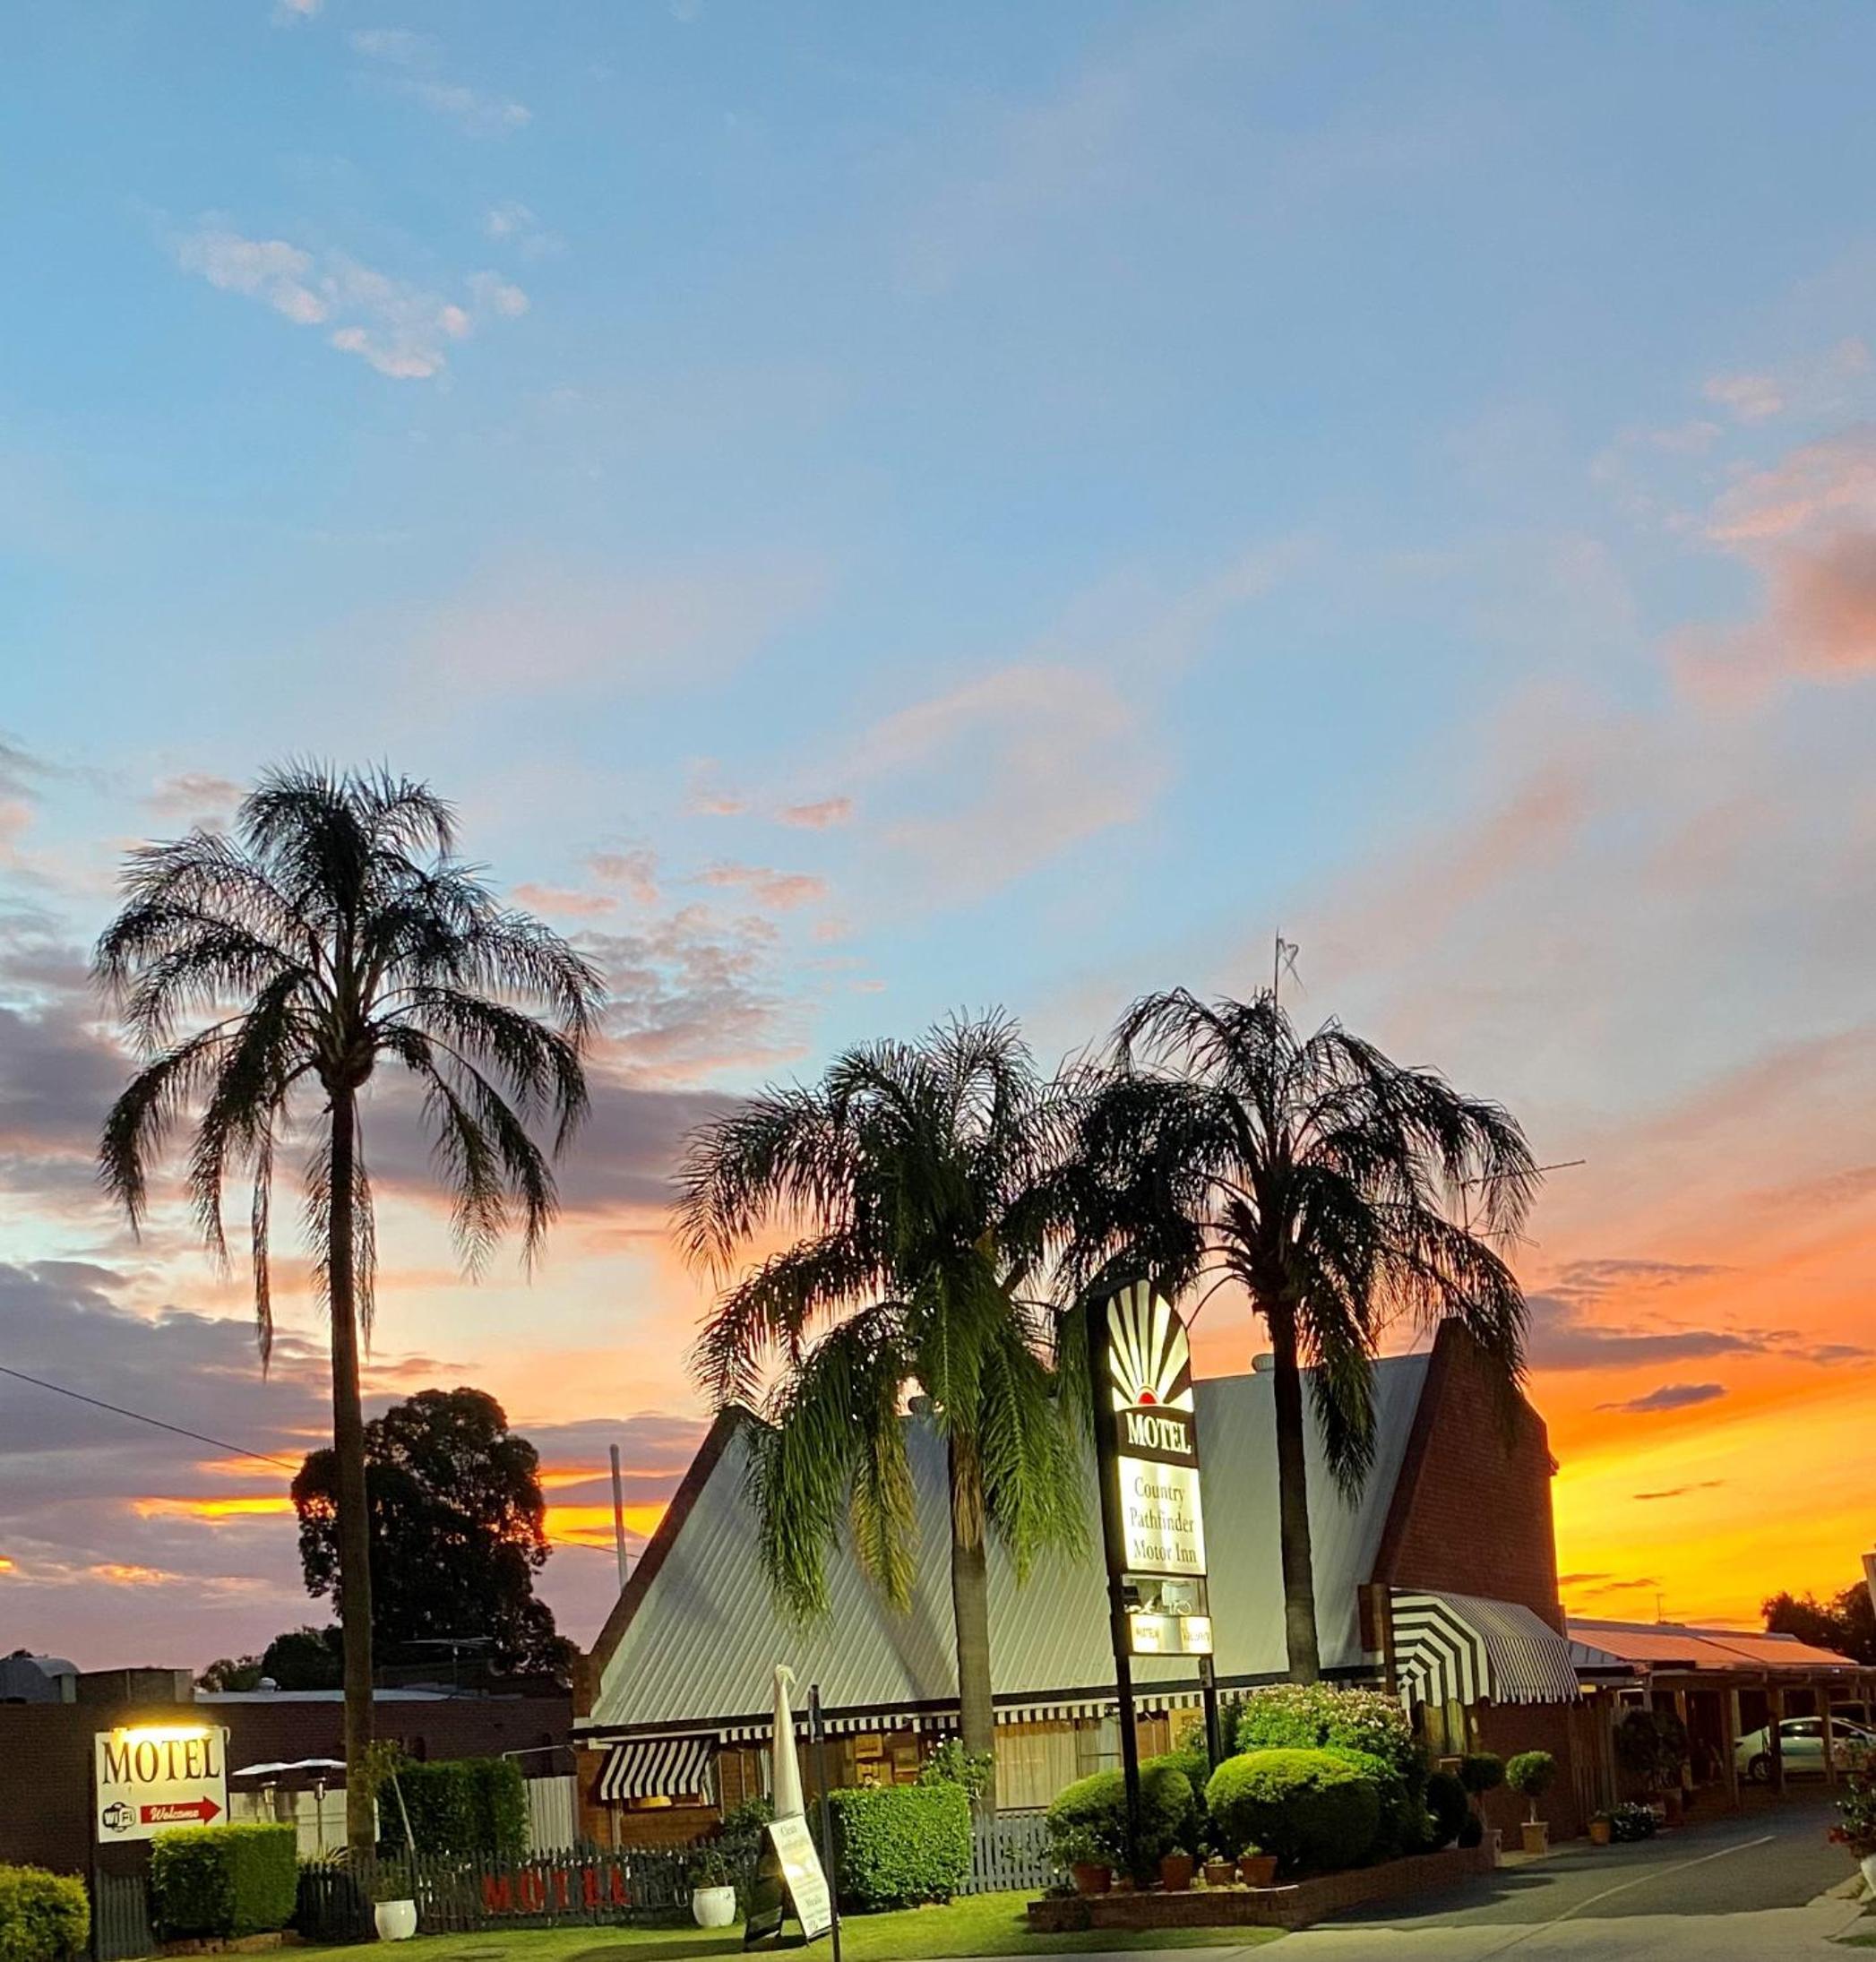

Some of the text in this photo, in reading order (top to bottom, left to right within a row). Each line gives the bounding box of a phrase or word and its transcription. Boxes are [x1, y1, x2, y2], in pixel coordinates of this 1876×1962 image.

[1125, 1412, 1191, 1454] MOTEL
[1134, 1476, 1184, 1509] Country
[1130, 1507, 1194, 1533] Pathfinder
[1133, 1538, 1197, 1563] Motor Inn
[102, 1739, 220, 1785] MOTEL
[150, 1805, 199, 1820] Welcome
